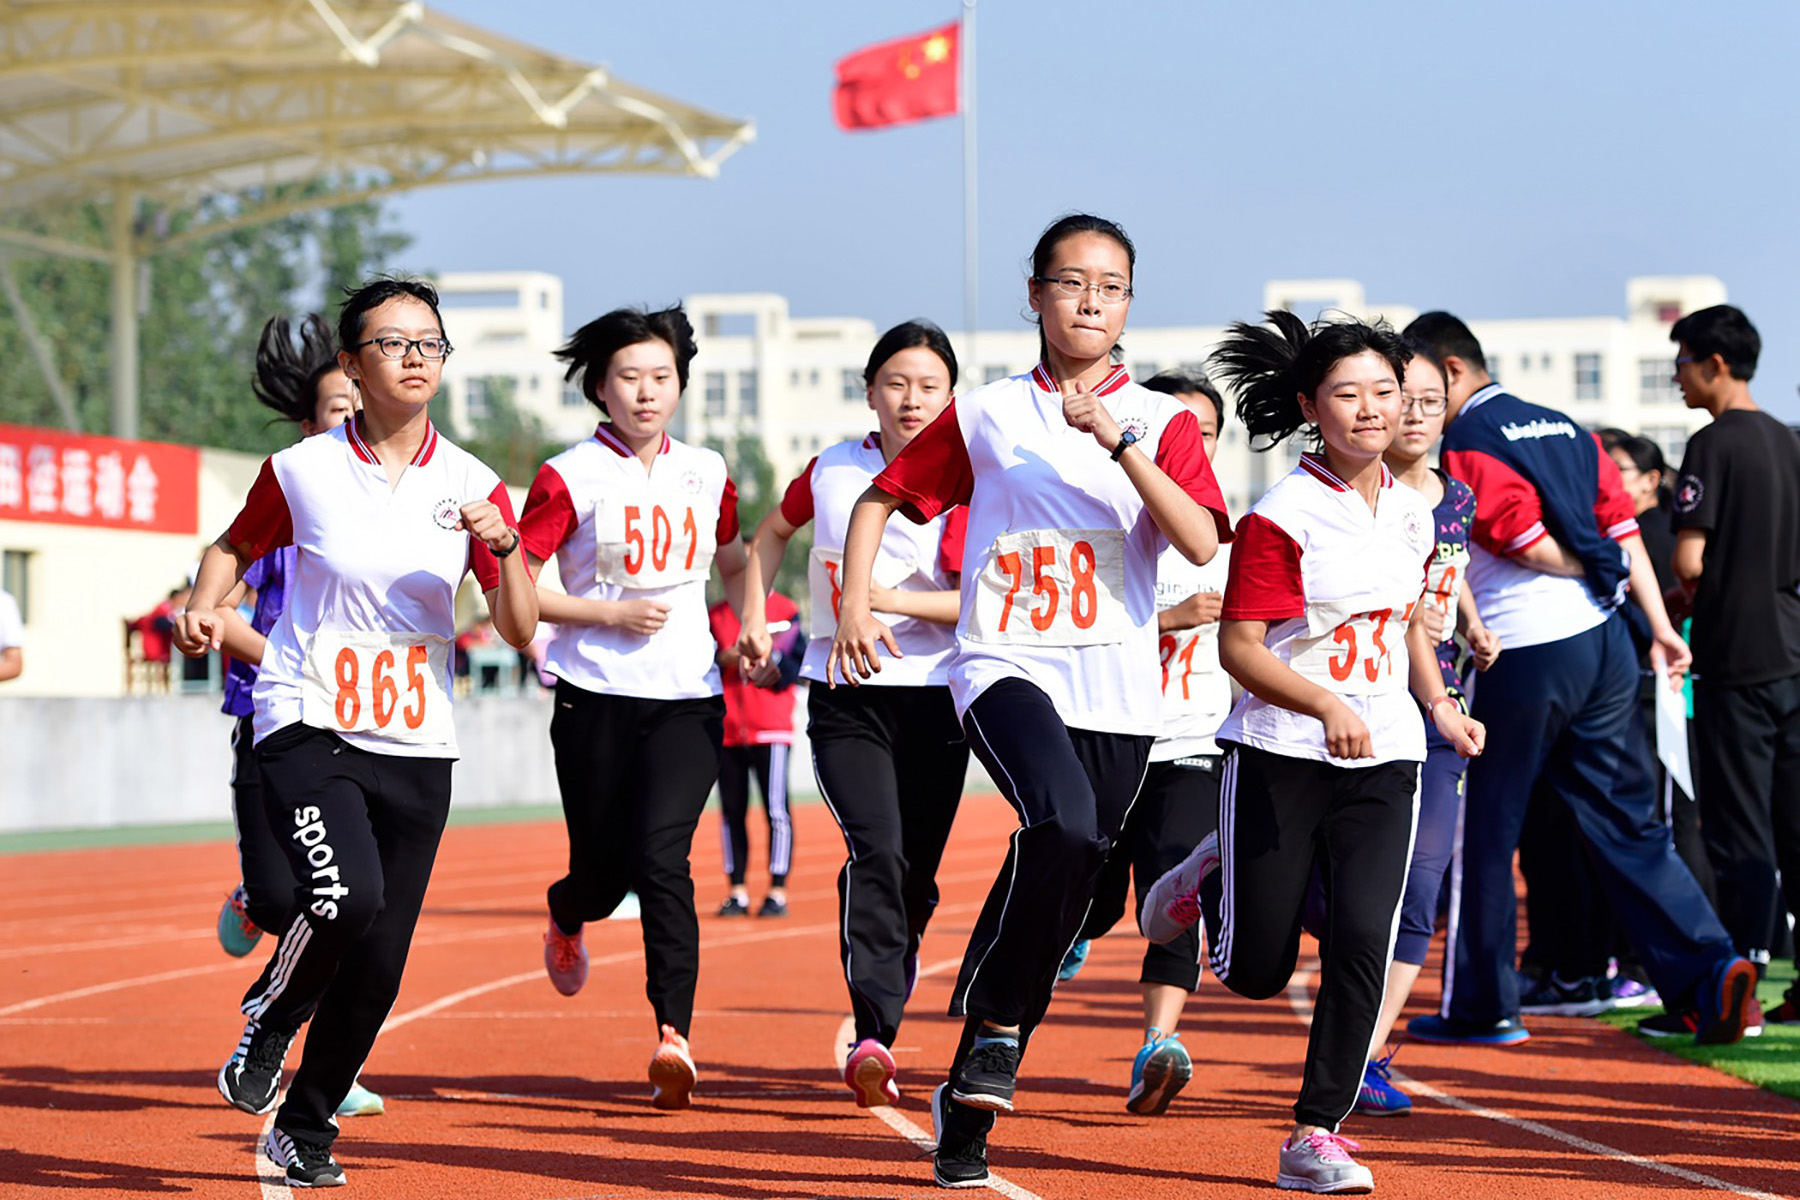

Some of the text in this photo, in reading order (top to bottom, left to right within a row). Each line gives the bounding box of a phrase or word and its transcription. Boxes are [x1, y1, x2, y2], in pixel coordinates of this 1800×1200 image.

[624, 504, 697, 575] 501
[997, 540, 1098, 632] 758
[334, 644, 428, 730] 865
[292, 804, 350, 921] sports
